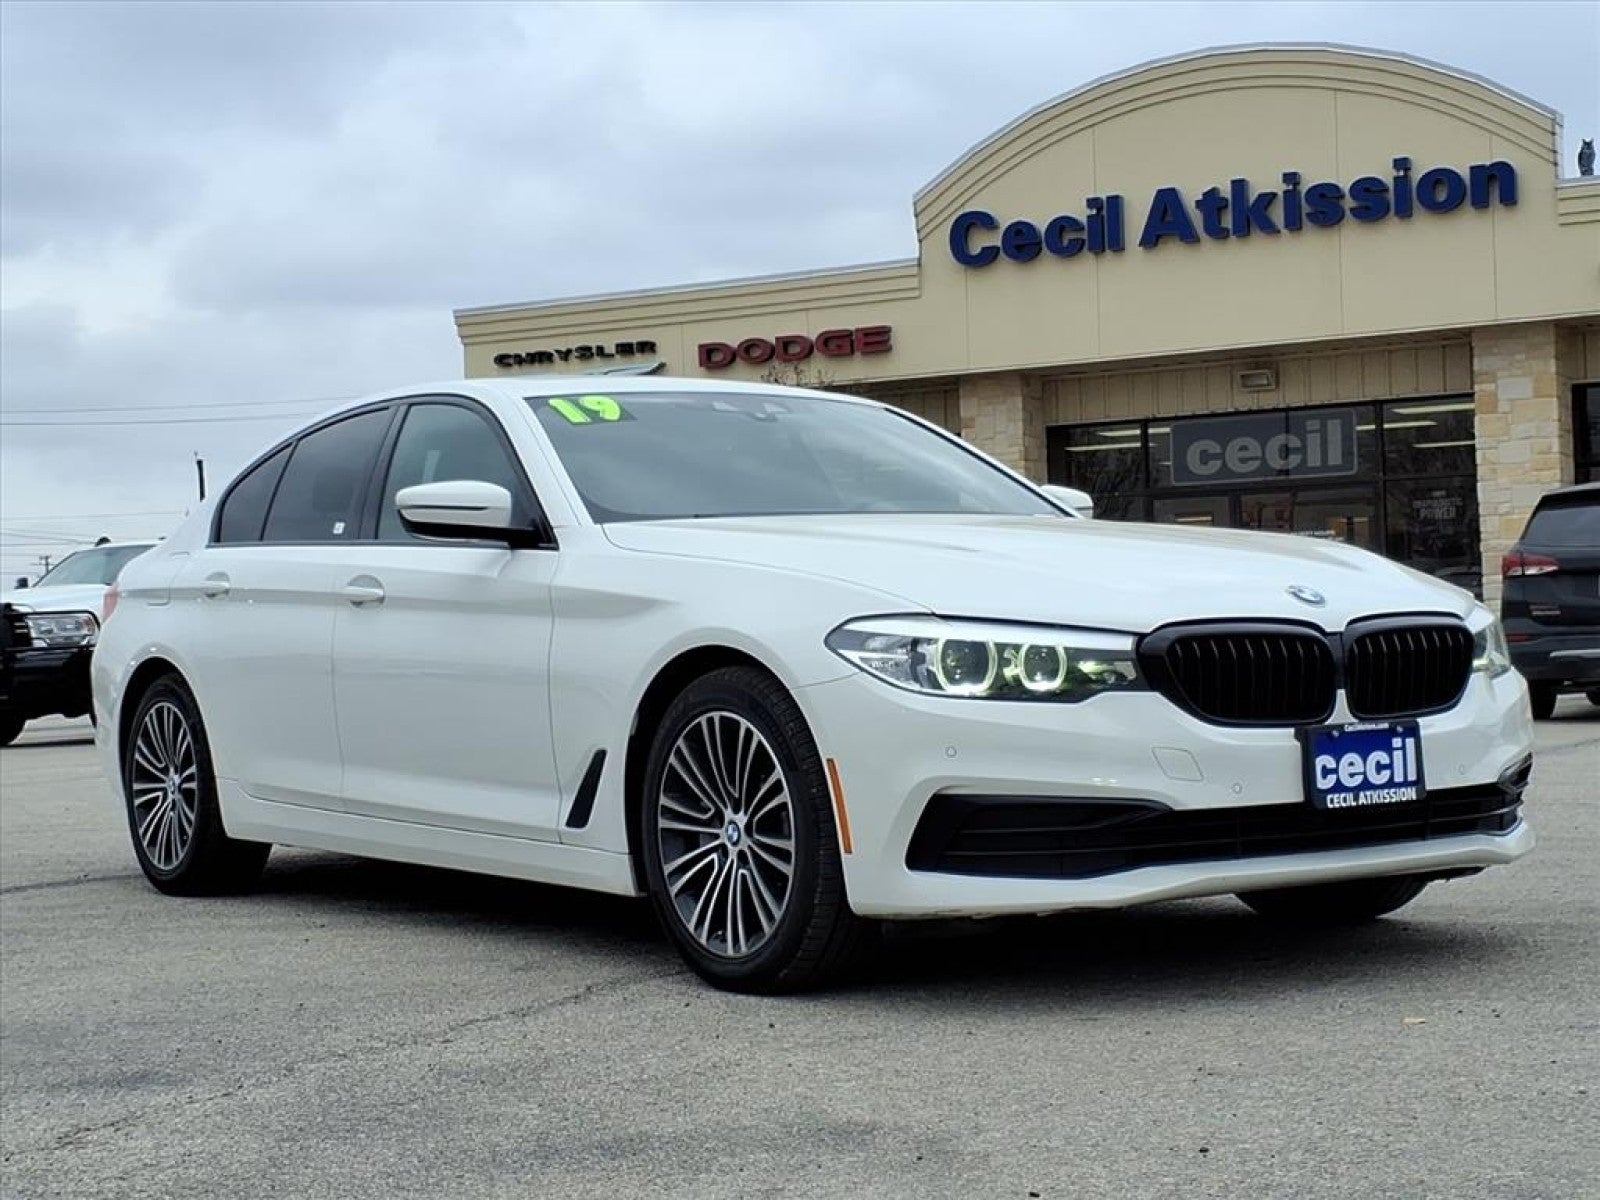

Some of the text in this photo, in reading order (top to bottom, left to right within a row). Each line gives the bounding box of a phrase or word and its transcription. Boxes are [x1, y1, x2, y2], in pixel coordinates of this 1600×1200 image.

[950, 156, 1518, 268] Cecil Atkission
[494, 340, 657, 367] CHRYSLER
[698, 325, 892, 368] DODGE
[549, 396, 622, 425] 19
[1186, 418, 1342, 476] cecil
[1315, 738, 1417, 789] cecil
[1327, 787, 1417, 808] CECIL ATKISSION
